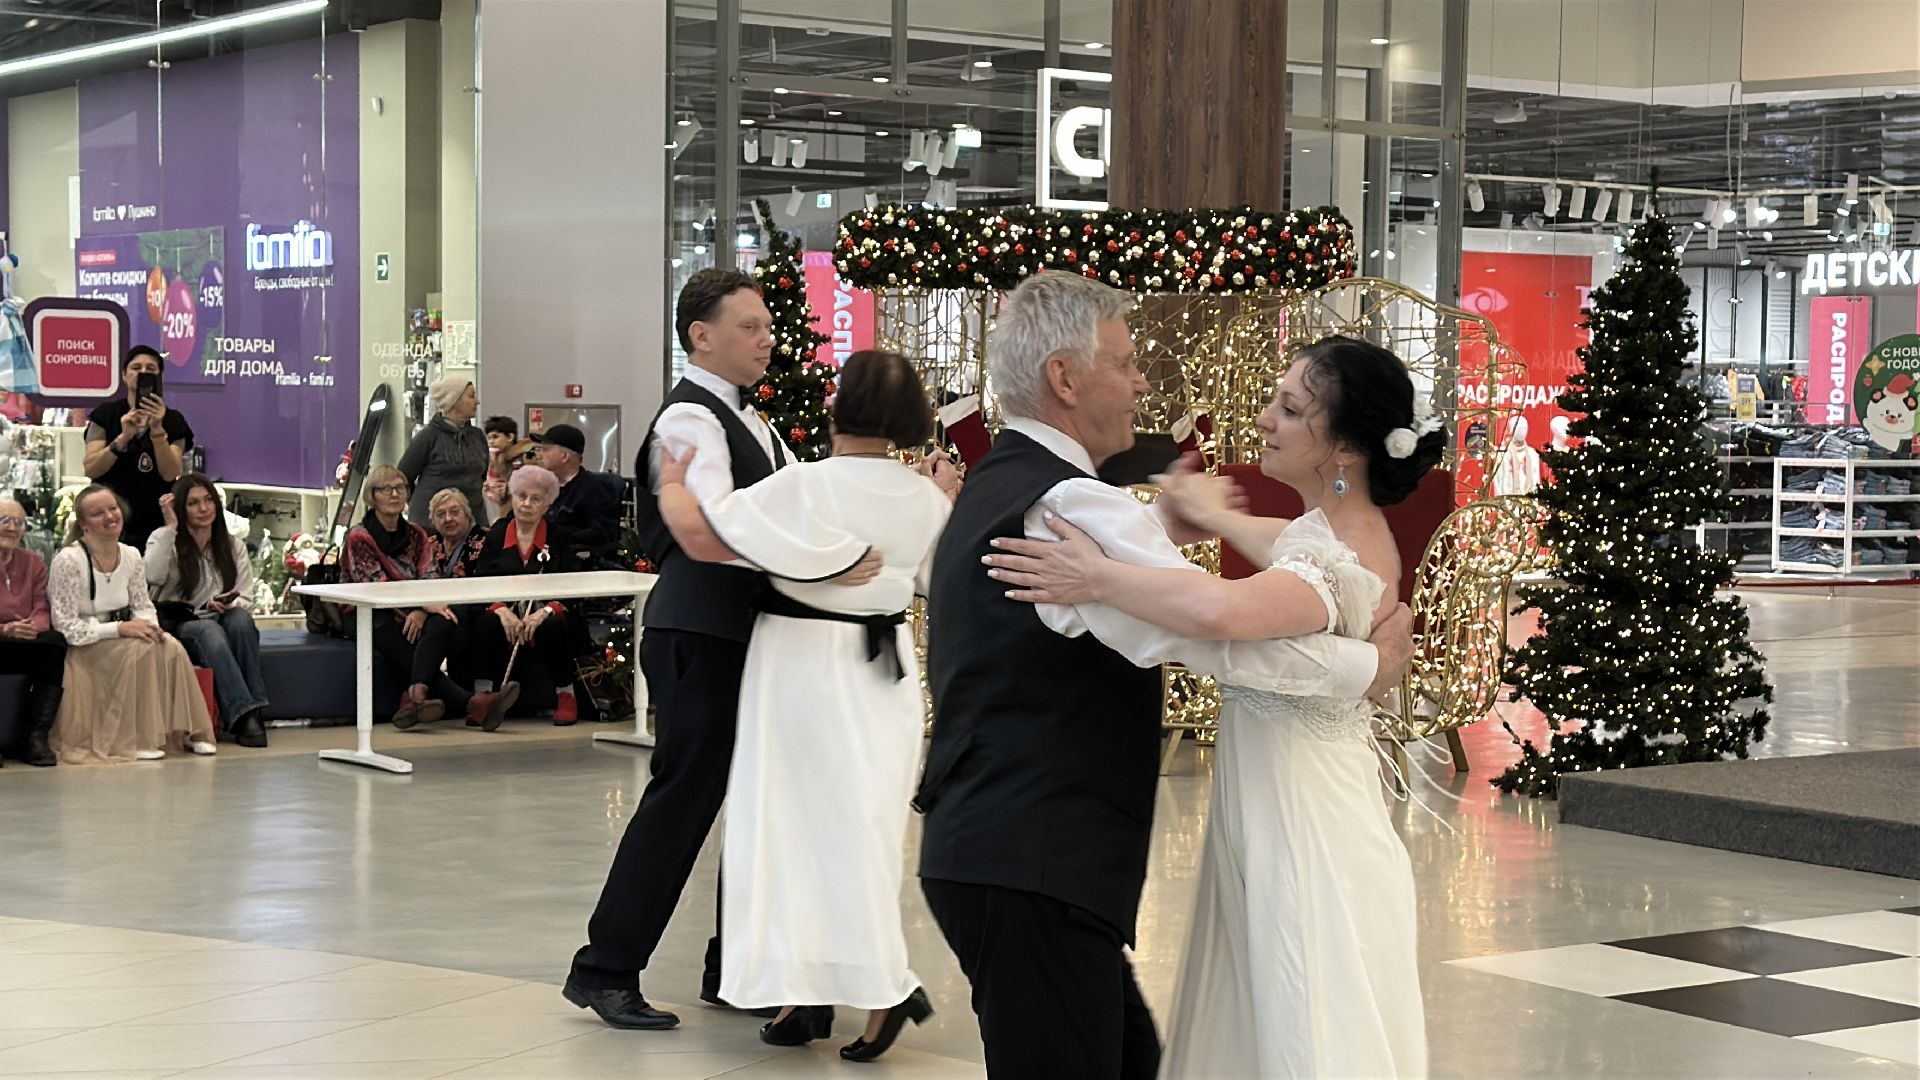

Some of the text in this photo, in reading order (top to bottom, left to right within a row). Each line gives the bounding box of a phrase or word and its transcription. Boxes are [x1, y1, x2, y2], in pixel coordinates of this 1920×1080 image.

[1056, 105, 1111, 178] C
[246, 219, 331, 271] familia
[79, 269, 147, 286] Копите скидки
[200, 285, 224, 308] -15%
[163, 312, 195, 339] -20%
[57, 339, 95, 350] ПОИСК
[214, 337, 275, 353] ТОВАРЫ
[372, 342, 433, 358] ОДЕЖДА
[1881, 347, 1920, 357] С НОВ
[45, 353, 107, 367] СОКРОВИЩ
[204, 360, 285, 377] ДЛЯ ДОМА
[1826, 312, 1847, 424] РАСПРОД
[380, 363, 425, 379] ОБУВЬ
